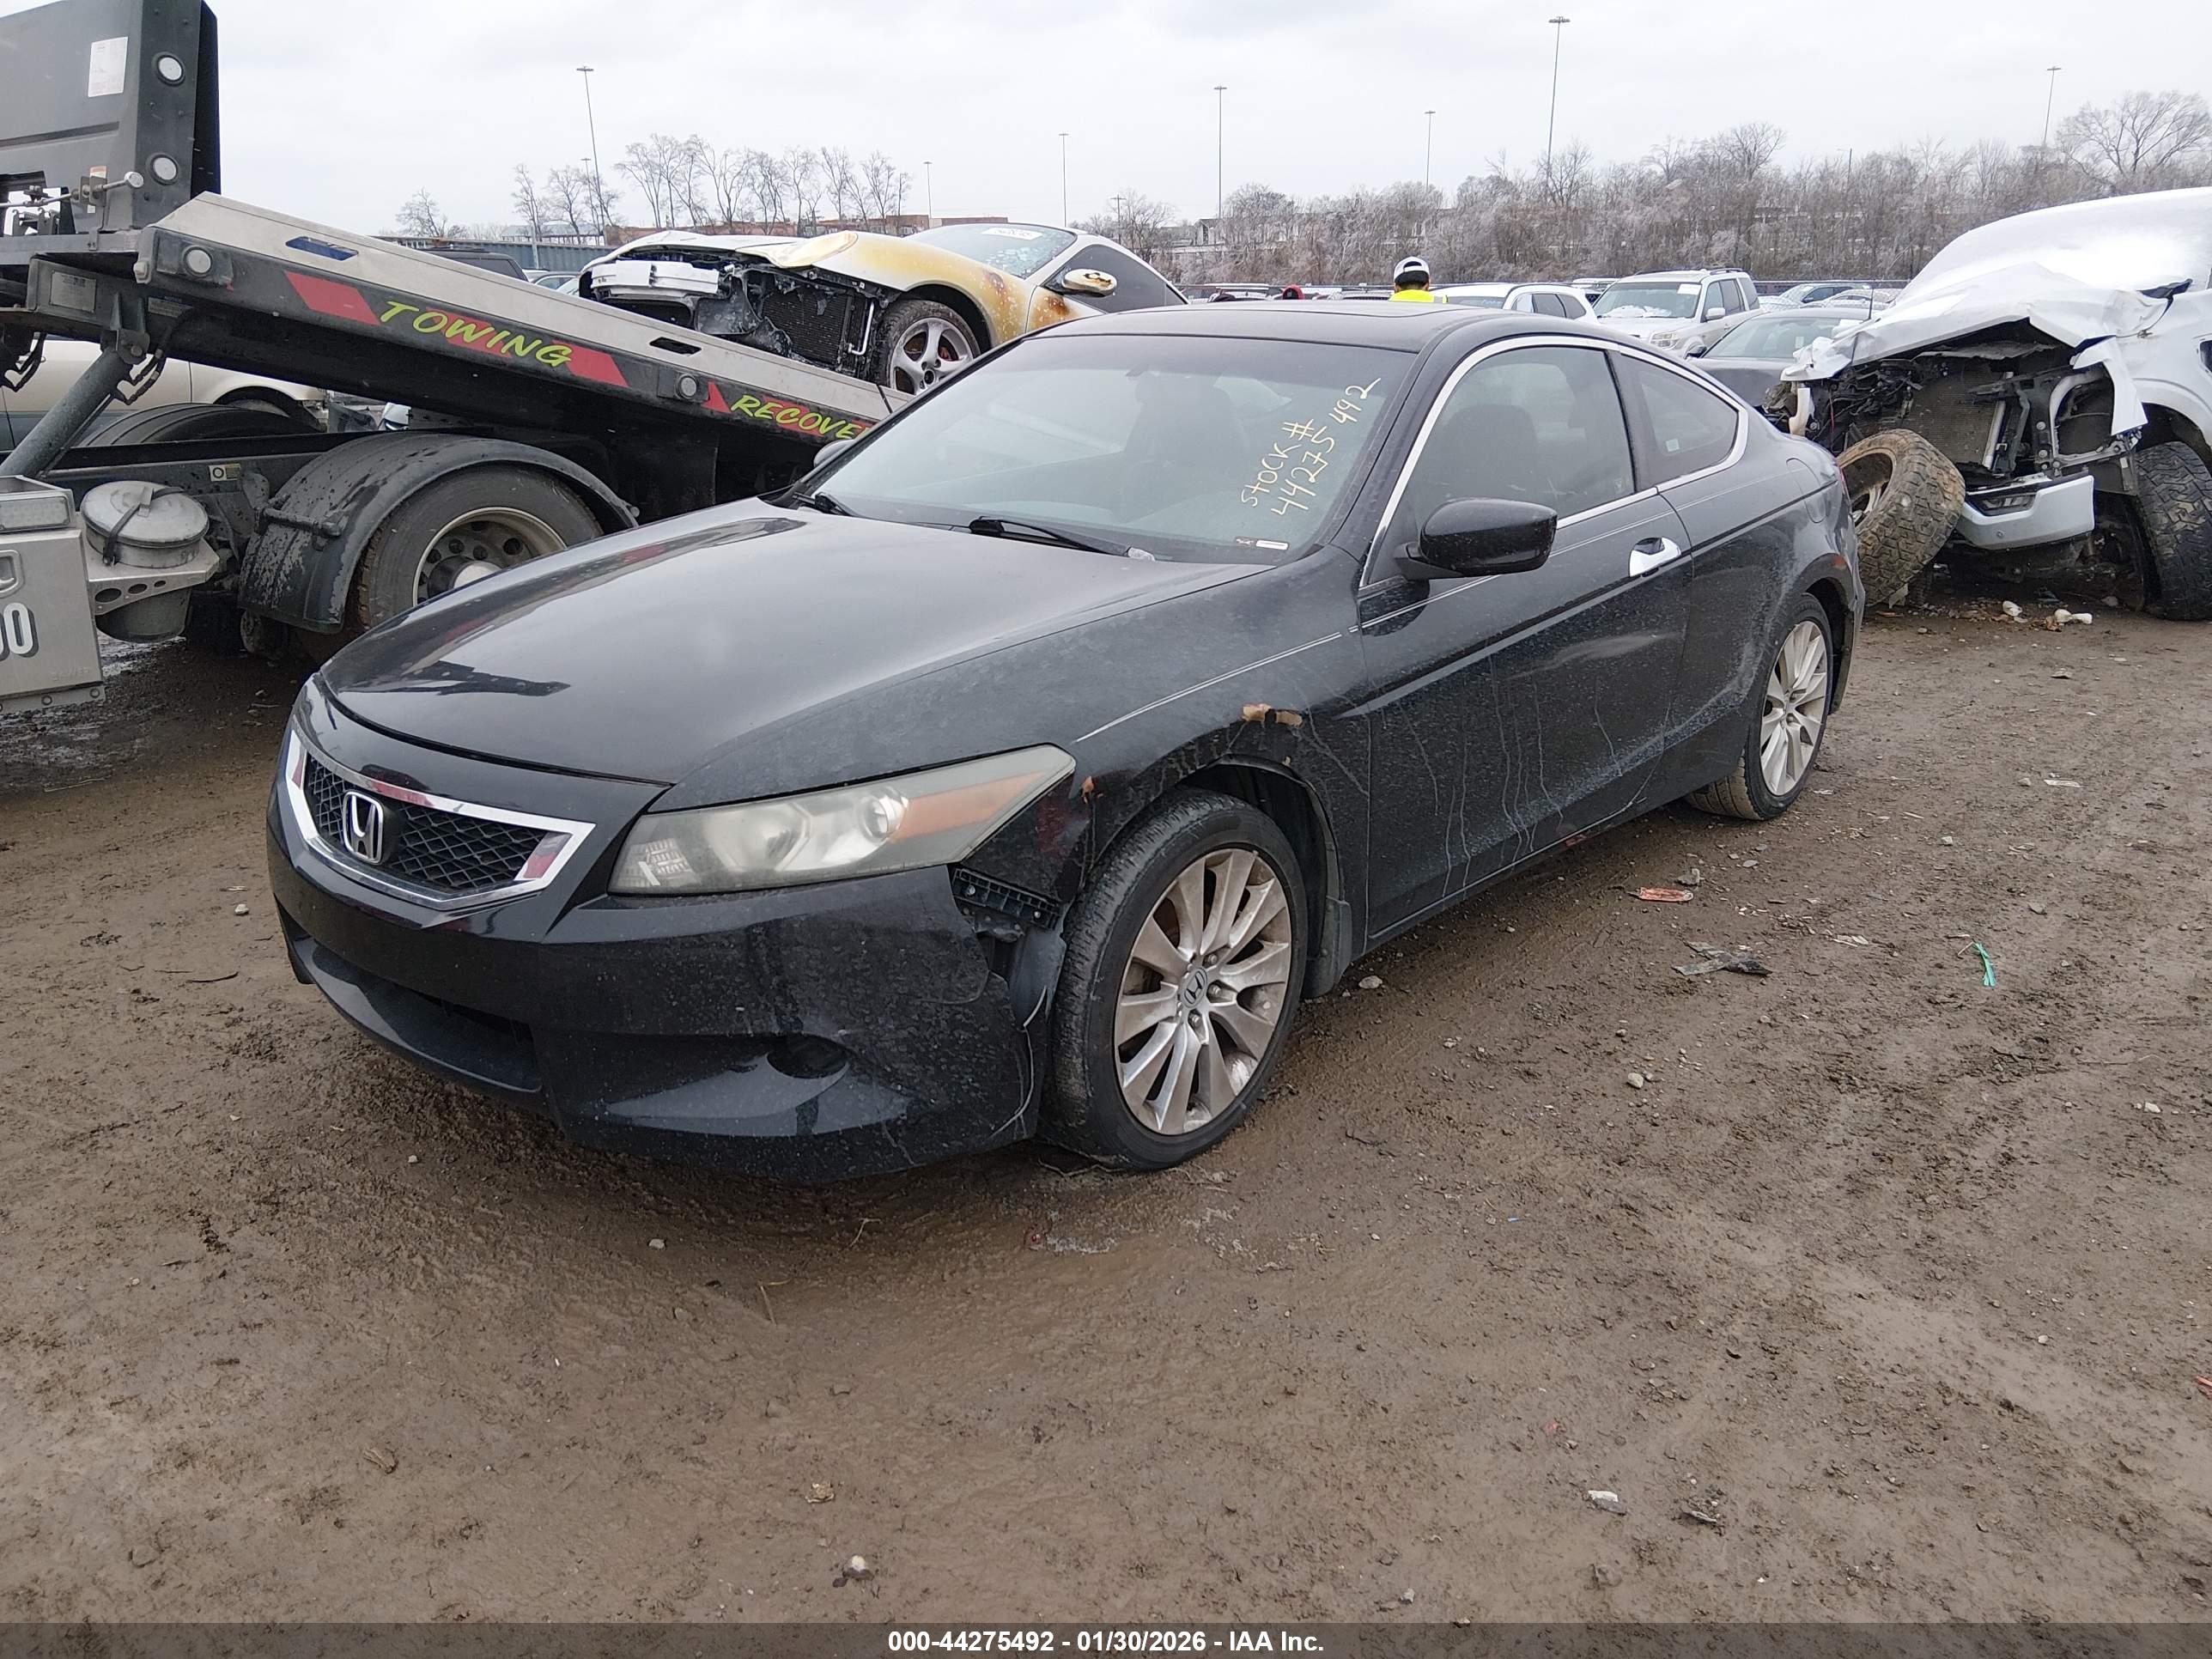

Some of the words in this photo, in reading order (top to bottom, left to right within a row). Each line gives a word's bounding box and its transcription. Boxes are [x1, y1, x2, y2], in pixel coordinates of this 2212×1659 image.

[380, 301, 574, 368] TOWING
[730, 394, 872, 440] RECOVE
[1281, 418, 1316, 441] #
[1271, 426, 1335, 515] 44275
[1328, 377, 1382, 424] 492
